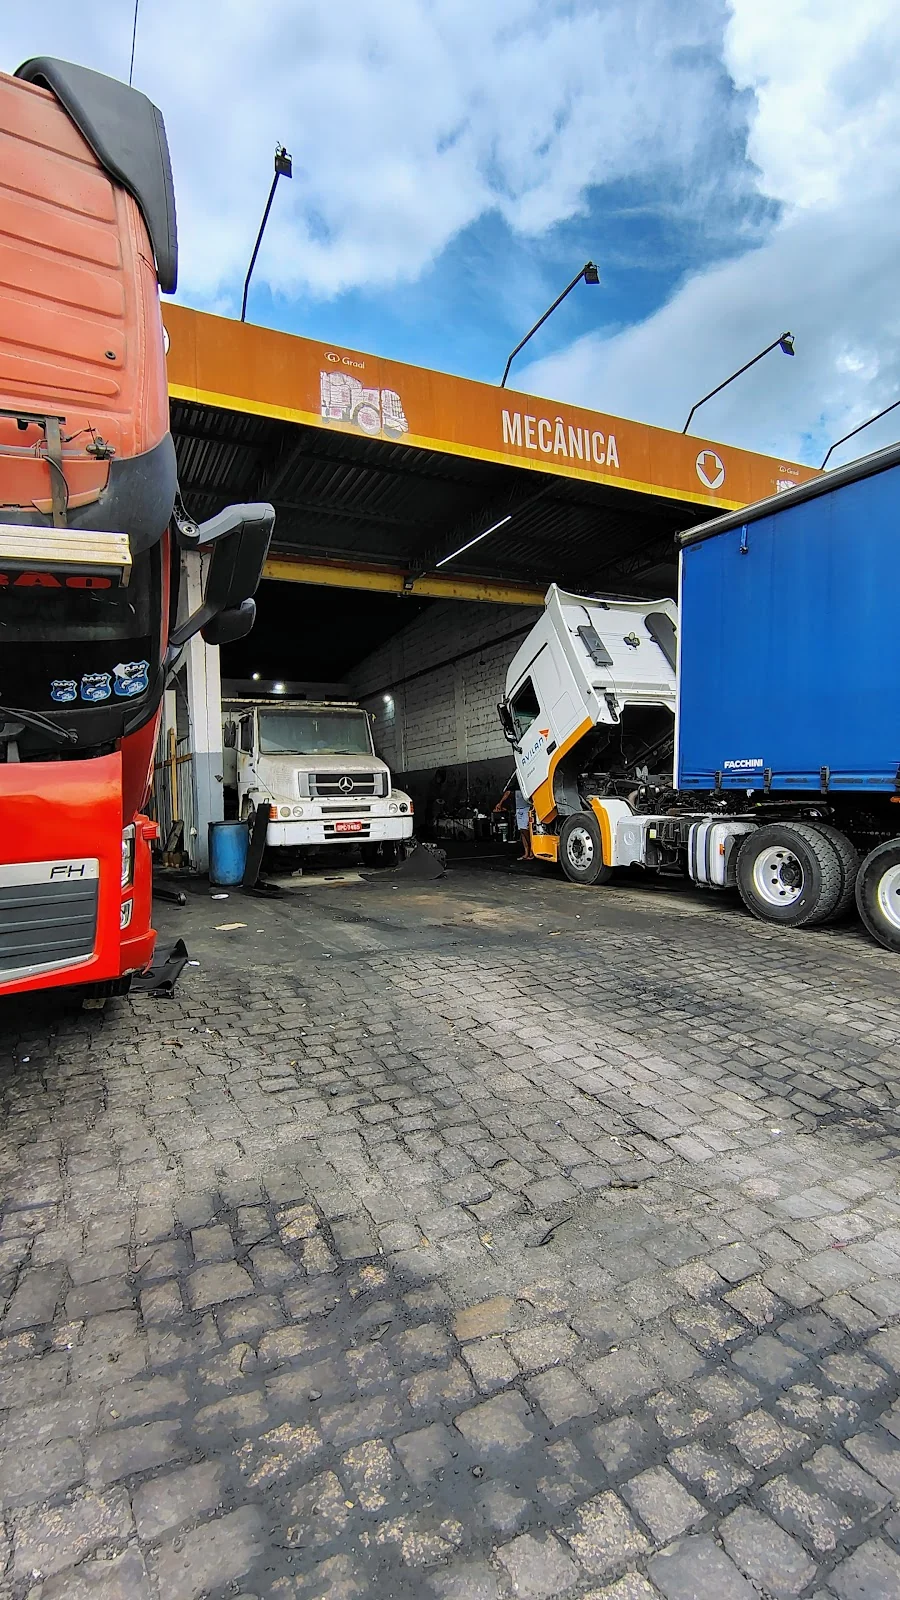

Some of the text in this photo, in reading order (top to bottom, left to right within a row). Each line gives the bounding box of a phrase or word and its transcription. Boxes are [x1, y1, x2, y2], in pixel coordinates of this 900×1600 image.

[342, 357, 365, 369] Graal
[501, 409, 620, 469] MECÂNICA
[724, 759, 763, 769] FACCHINI
[50, 864, 85, 879] FH
